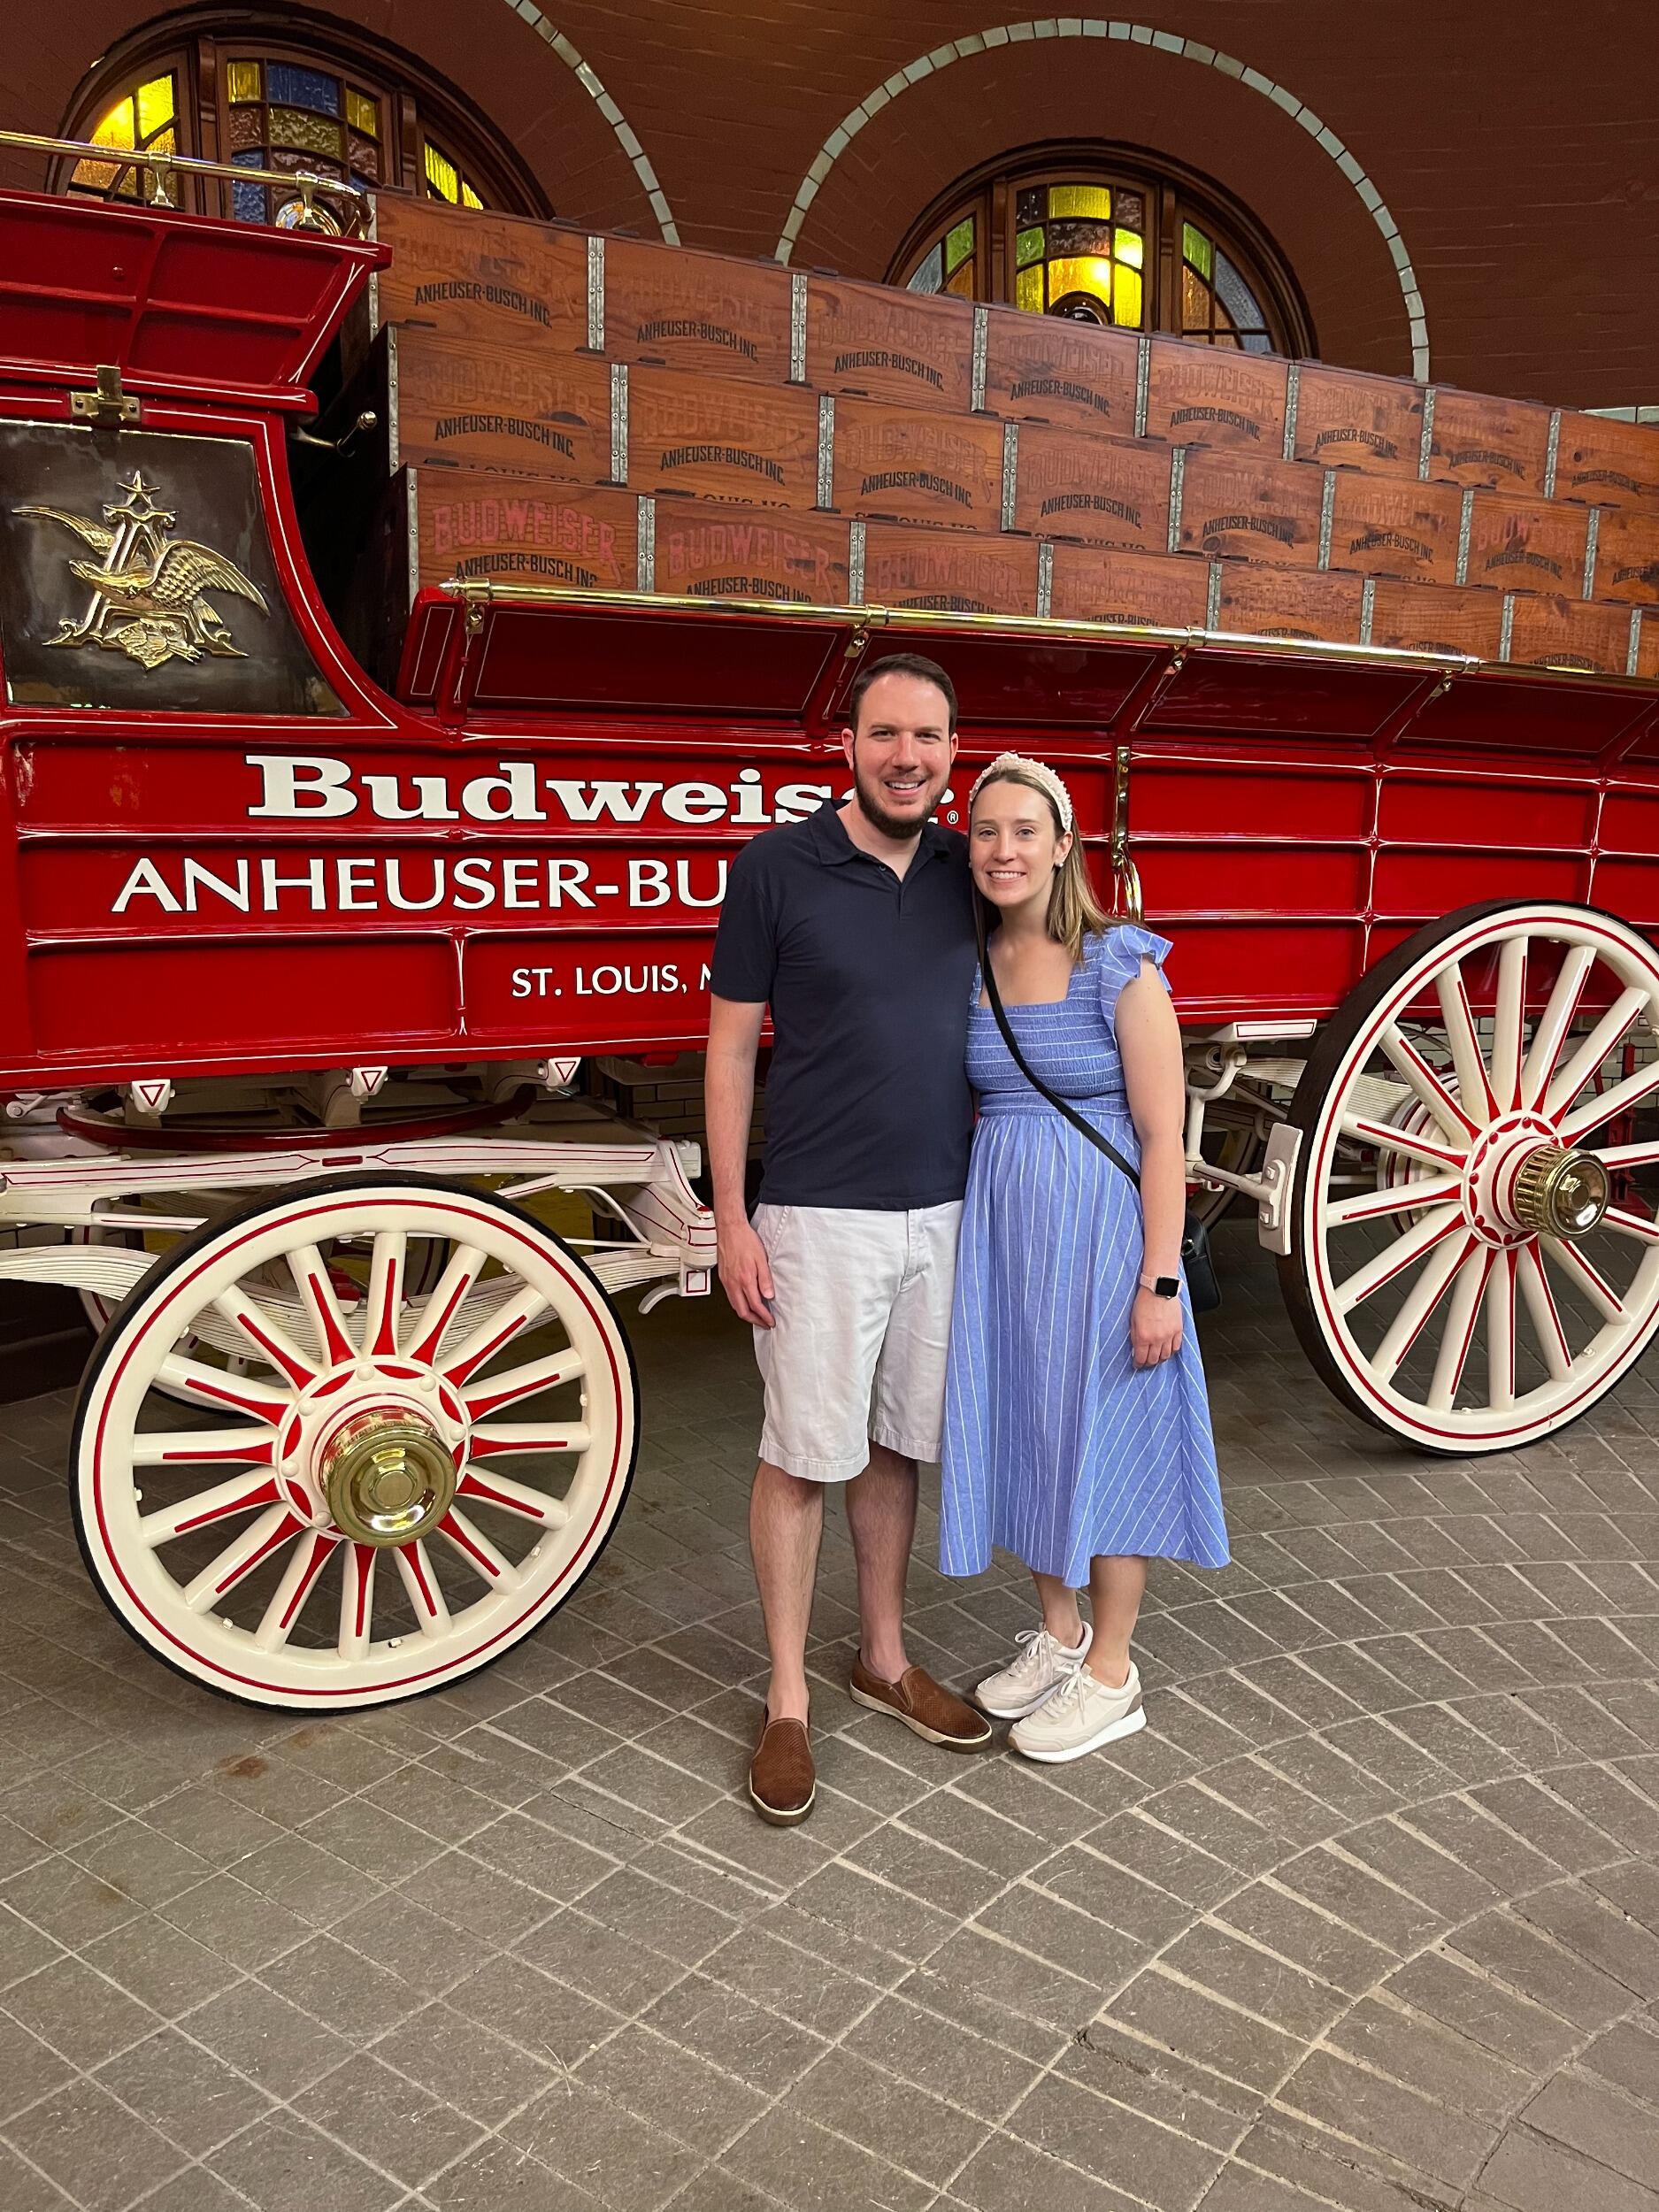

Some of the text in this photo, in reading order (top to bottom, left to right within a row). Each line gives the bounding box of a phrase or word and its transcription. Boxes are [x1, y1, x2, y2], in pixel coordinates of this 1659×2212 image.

[637, 319, 737, 349] ANHEUSER-BUSCH
[1010, 379, 1093, 404] ANHEUSER-BUSCH
[434, 414, 550, 443] ANHEUSER-BUSCH
[1170, 406, 1245, 431] ANHEUSER-BUSCH
[660, 445, 763, 473] ANHEUSER-BUSCH
[1041, 494, 1124, 518] ANHEUSER-BUSCH
[1202, 515, 1278, 538] ANHEUSER-BUSCH
[432, 499, 625, 588] BUDWEISER
[456, 553, 574, 581] ANHEUSER-BUSCH
[668, 524, 834, 605] BUDWEISER
[687, 576, 790, 602] ANHEUSER-BUSCH
[245, 755, 954, 824] Budweis
[511, 967, 562, 997] ST.
[576, 964, 687, 995] LOUIS,
